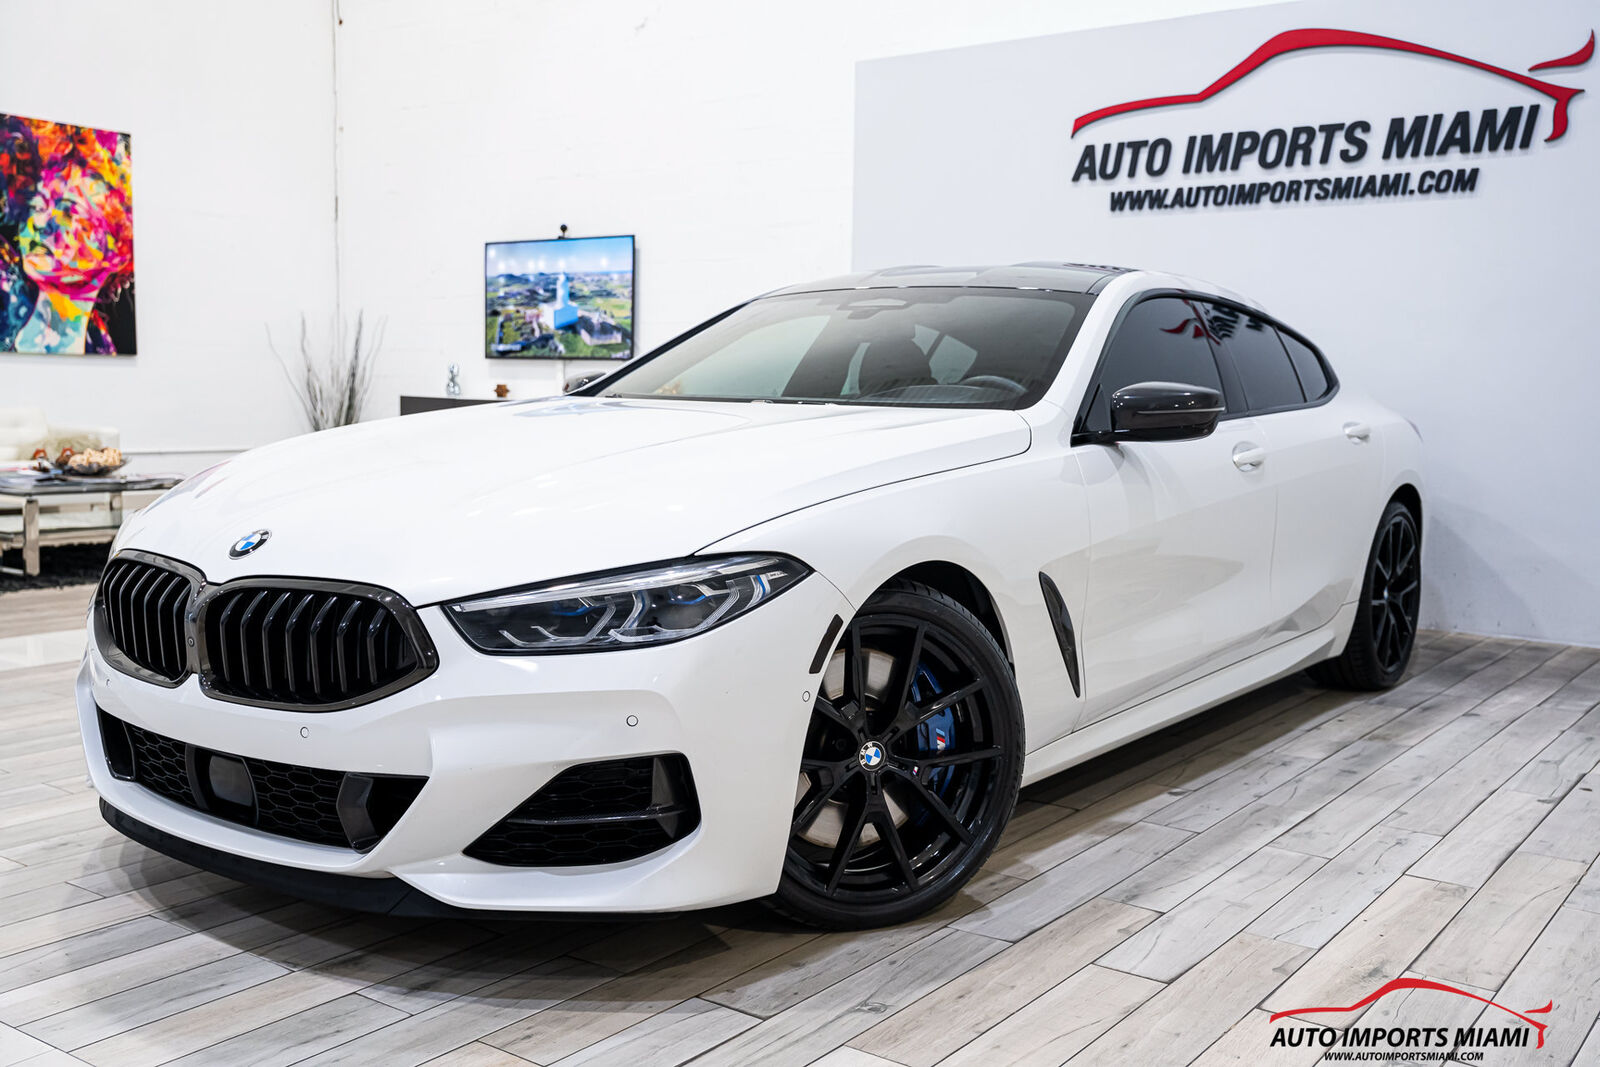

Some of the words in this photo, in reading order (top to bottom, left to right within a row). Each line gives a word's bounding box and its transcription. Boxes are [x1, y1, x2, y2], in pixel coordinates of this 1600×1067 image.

[1072, 138, 1172, 182] AUTO
[1182, 121, 1370, 173] IMPORTS
[1382, 104, 1540, 160] MIAMI
[1110, 168, 1479, 212] WWW.AUTOIMPORTSMIAMI.COM
